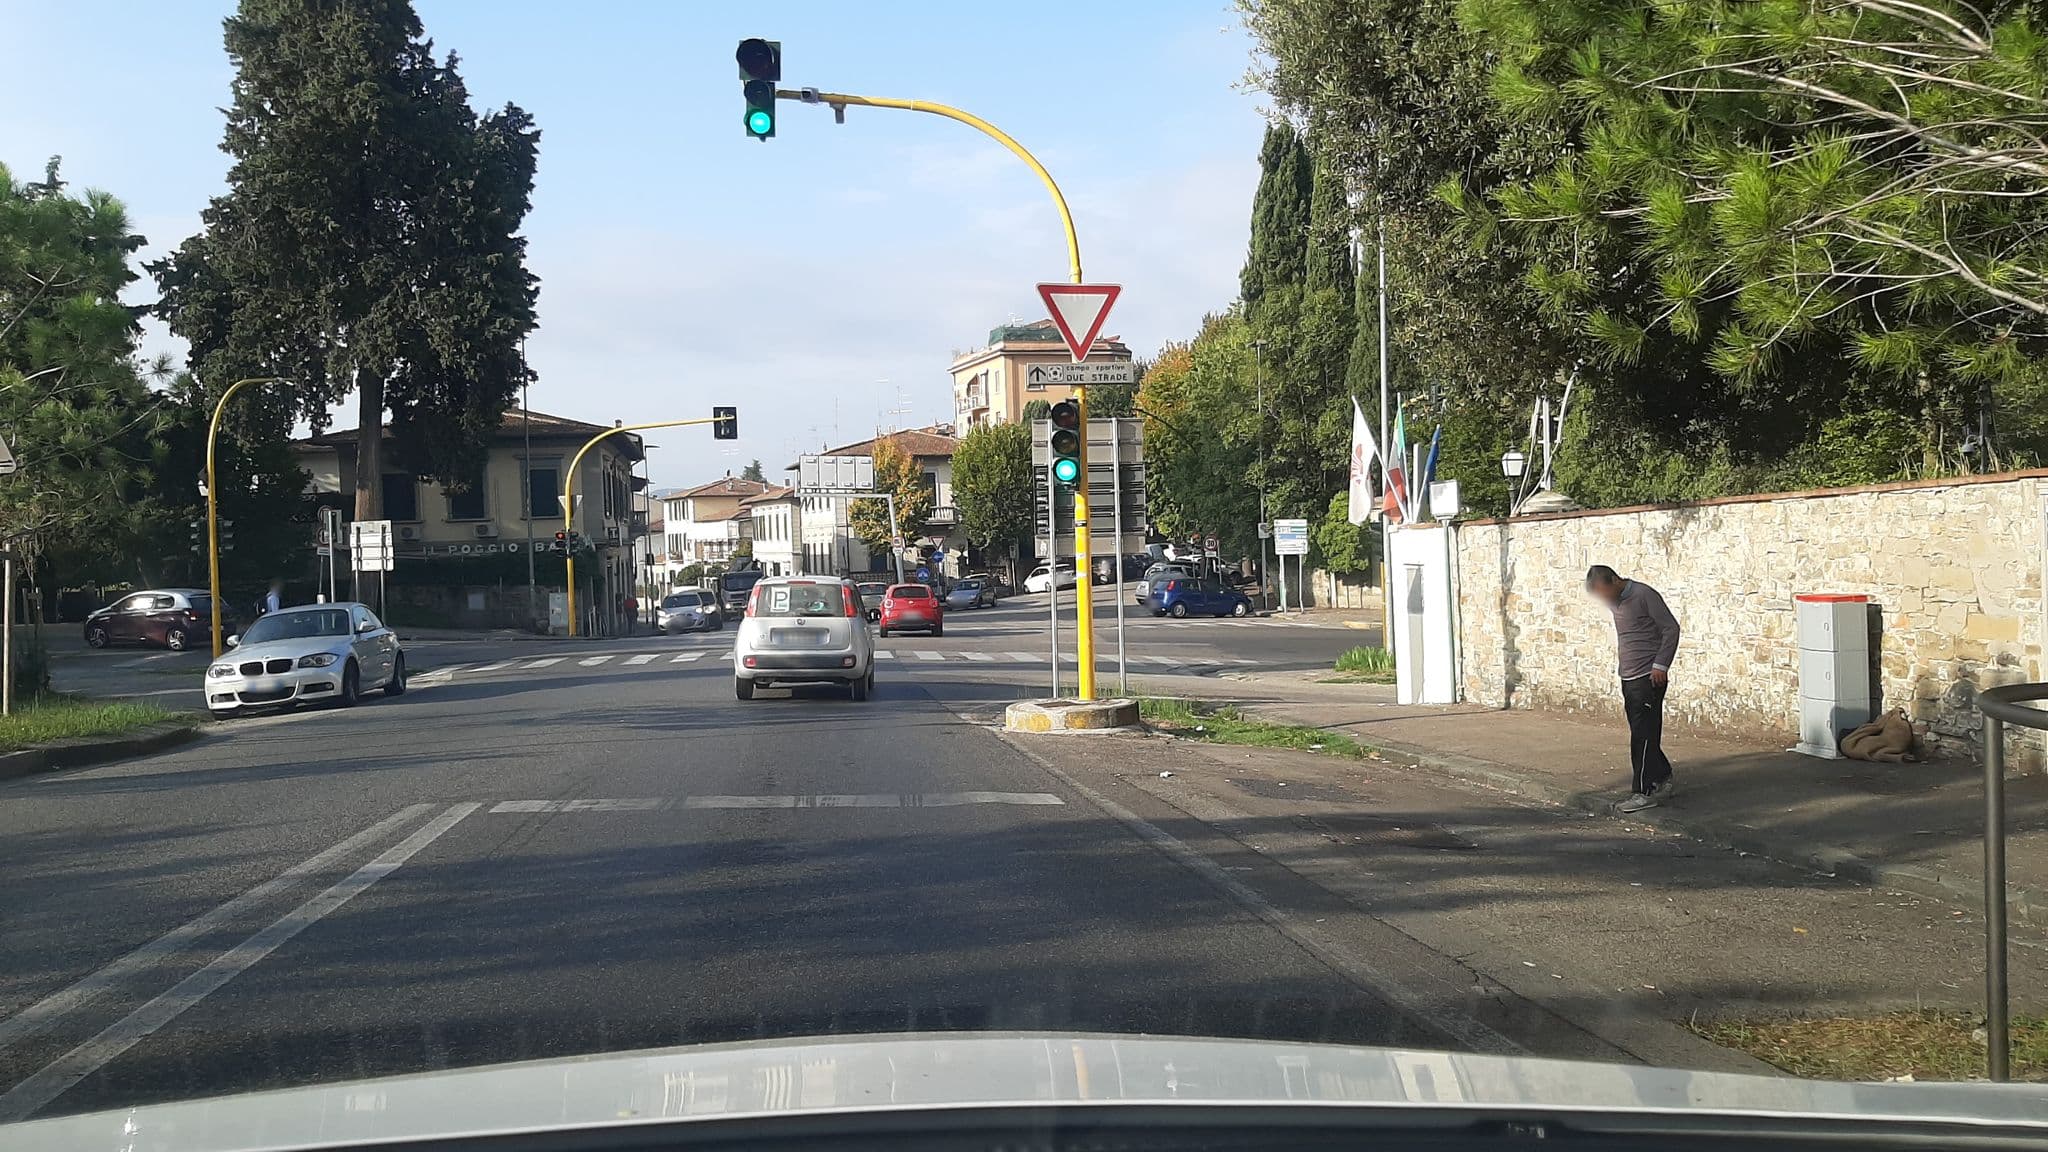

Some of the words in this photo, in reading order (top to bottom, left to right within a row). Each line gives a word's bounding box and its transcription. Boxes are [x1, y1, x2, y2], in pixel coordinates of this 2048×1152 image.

[1067, 374, 1085, 382] DUE
[1092, 373, 1128, 381] STRADE
[423, 545, 436, 555] IL
[448, 542, 518, 555] POGGIO
[775, 590, 788, 608] P
